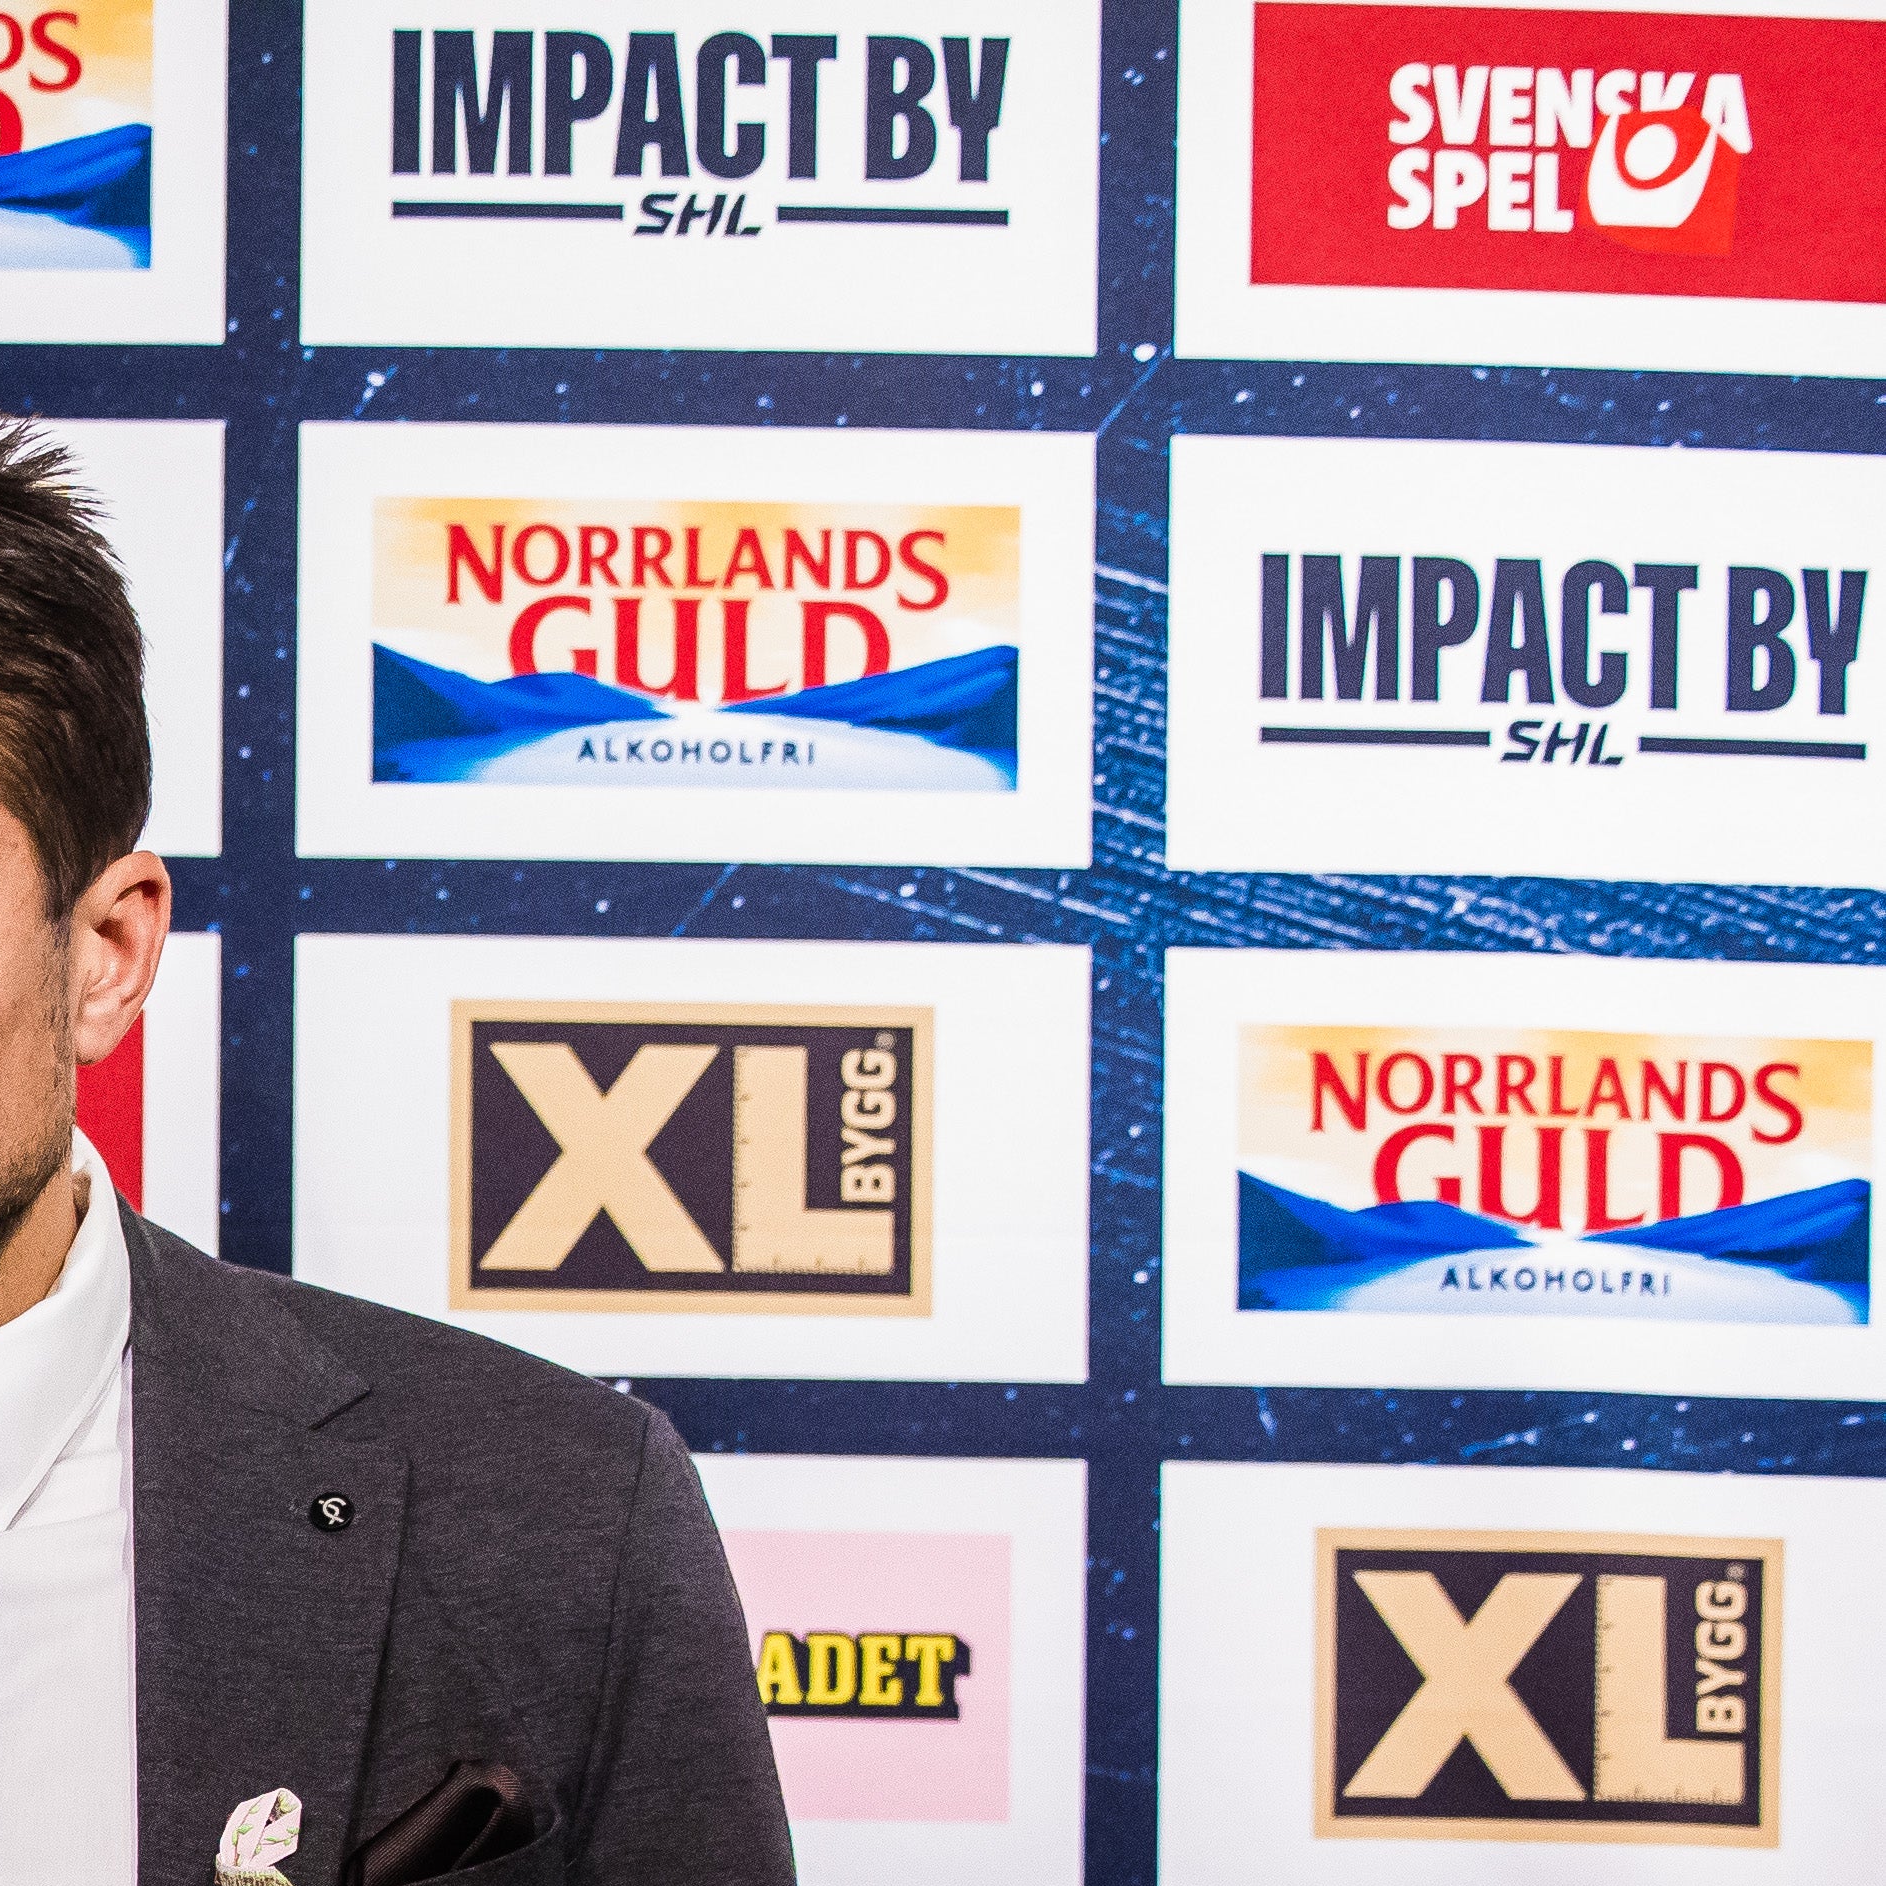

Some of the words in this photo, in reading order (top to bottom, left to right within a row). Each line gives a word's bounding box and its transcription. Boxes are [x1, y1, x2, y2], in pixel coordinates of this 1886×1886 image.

[392, 28, 838, 179] IMPACT
[865, 34, 1011, 182] BY
[1387, 61, 1752, 154] SVENSKA
[635, 193, 762, 236] SHL
[1387, 150, 1574, 234] SPEL
[448, 524, 948, 613] NORRLANDS
[510, 595, 890, 701] GULD
[1261, 553, 1699, 709] IMPACT
[1726, 565, 1869, 716] BY
[577, 736, 817, 767] ALKOHOLFRI
[1502, 720, 1623, 766] SHL
[841, 1047, 896, 1204] BYGG
[1313, 1052, 1803, 1149] NORRLANDS
[479, 1040, 895, 1275] XL
[1374, 1123, 1744, 1230] GULD
[1439, 1262, 1672, 1298] ALKOHOLFRI
[1344, 1569, 1745, 1806] XL
[1694, 1578, 1747, 1737] BYGG
